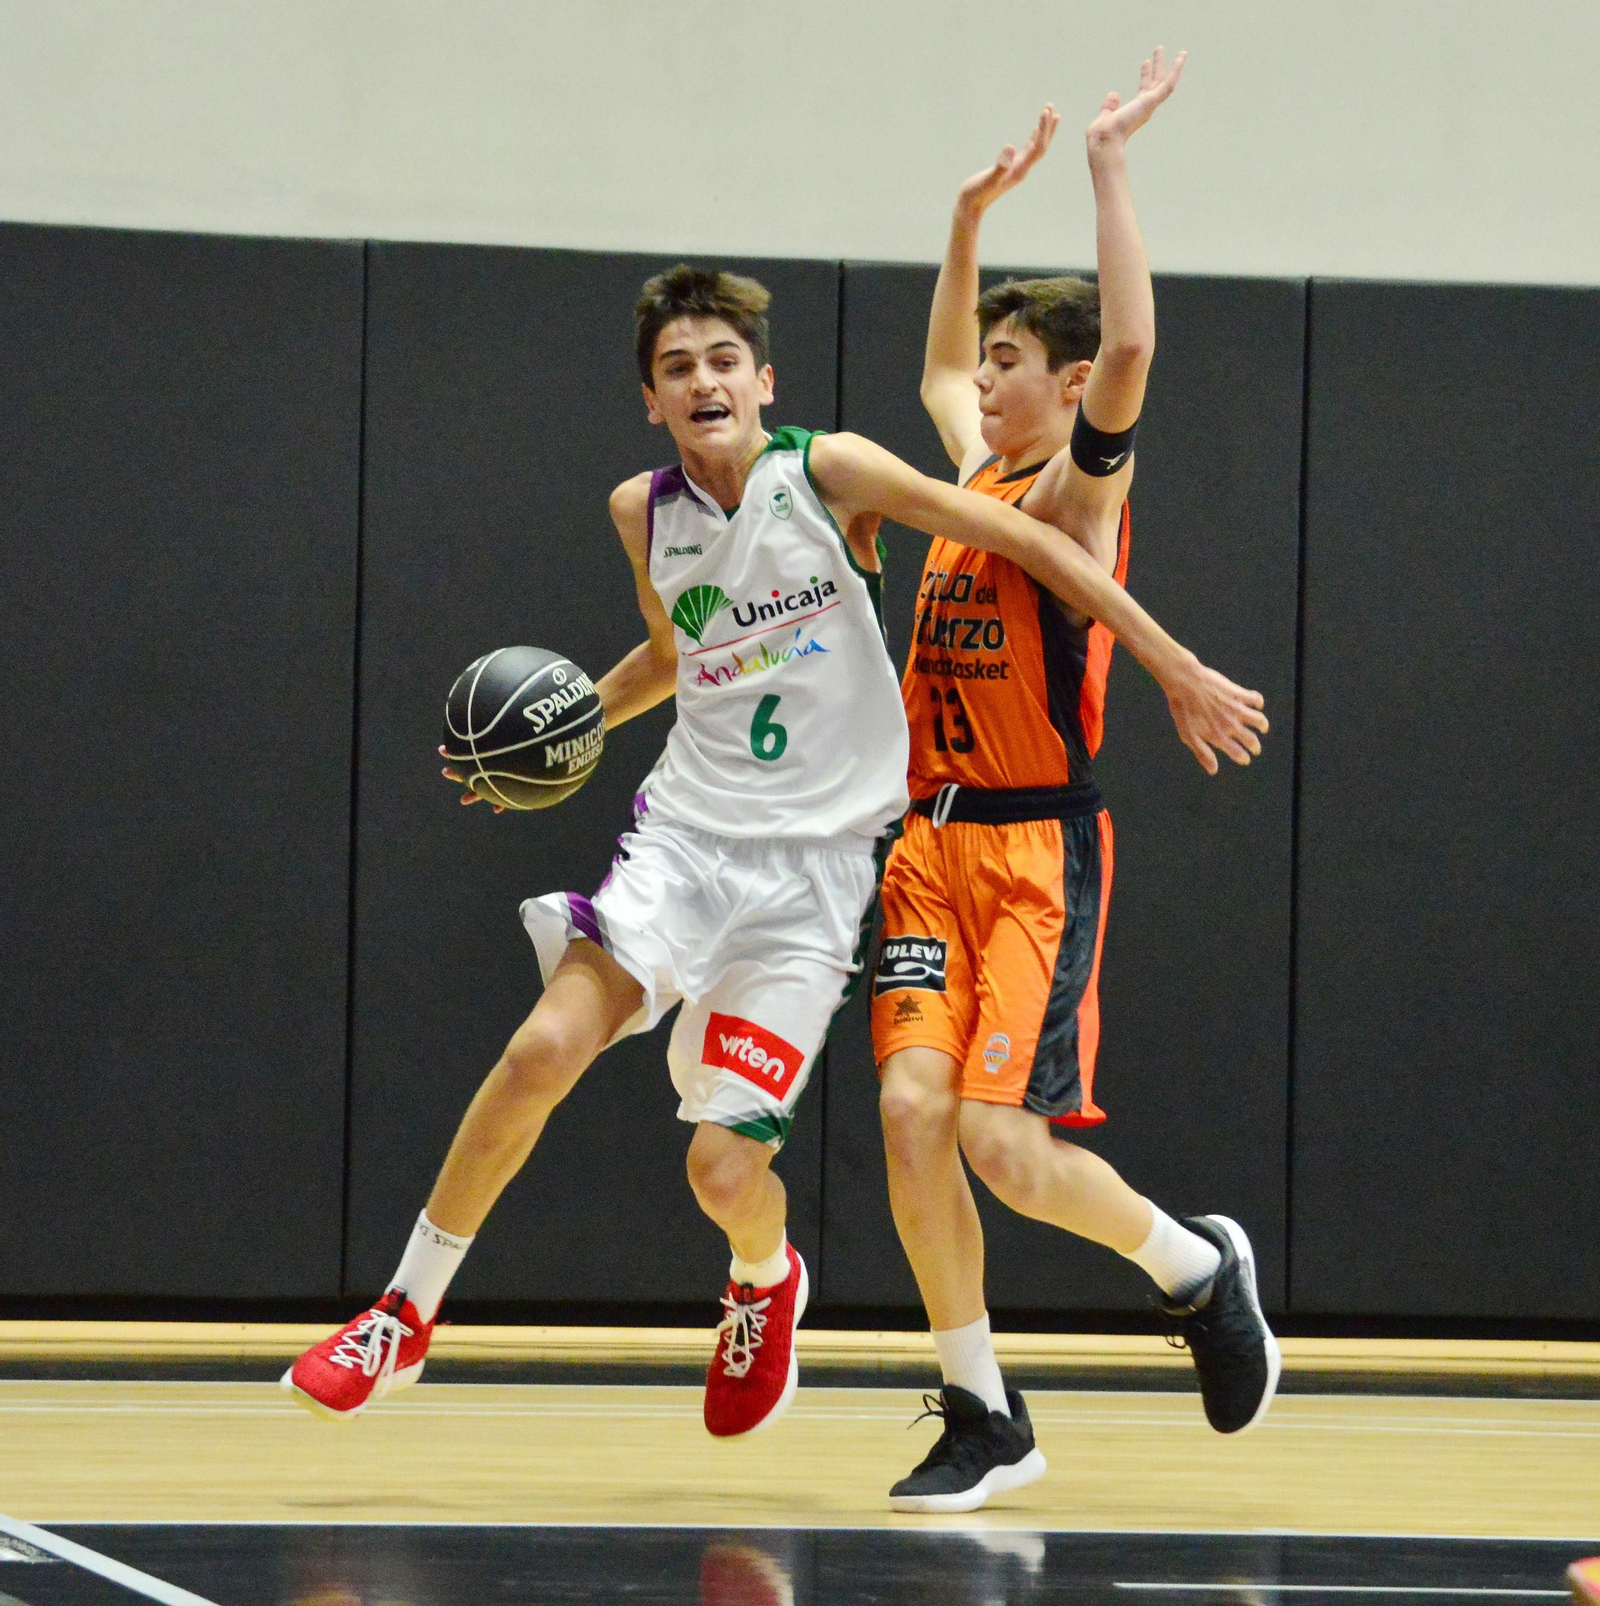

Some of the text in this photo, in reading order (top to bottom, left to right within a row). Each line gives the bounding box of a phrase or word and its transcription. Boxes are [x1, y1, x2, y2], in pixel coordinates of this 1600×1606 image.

[731, 575, 838, 628] Unicaja
[522, 672, 598, 735] SPALDIN
[750, 693, 788, 762] 6
[930, 685, 975, 754] 13
[567, 740, 604, 776] ENDES
[718, 1032, 786, 1083] wrten
